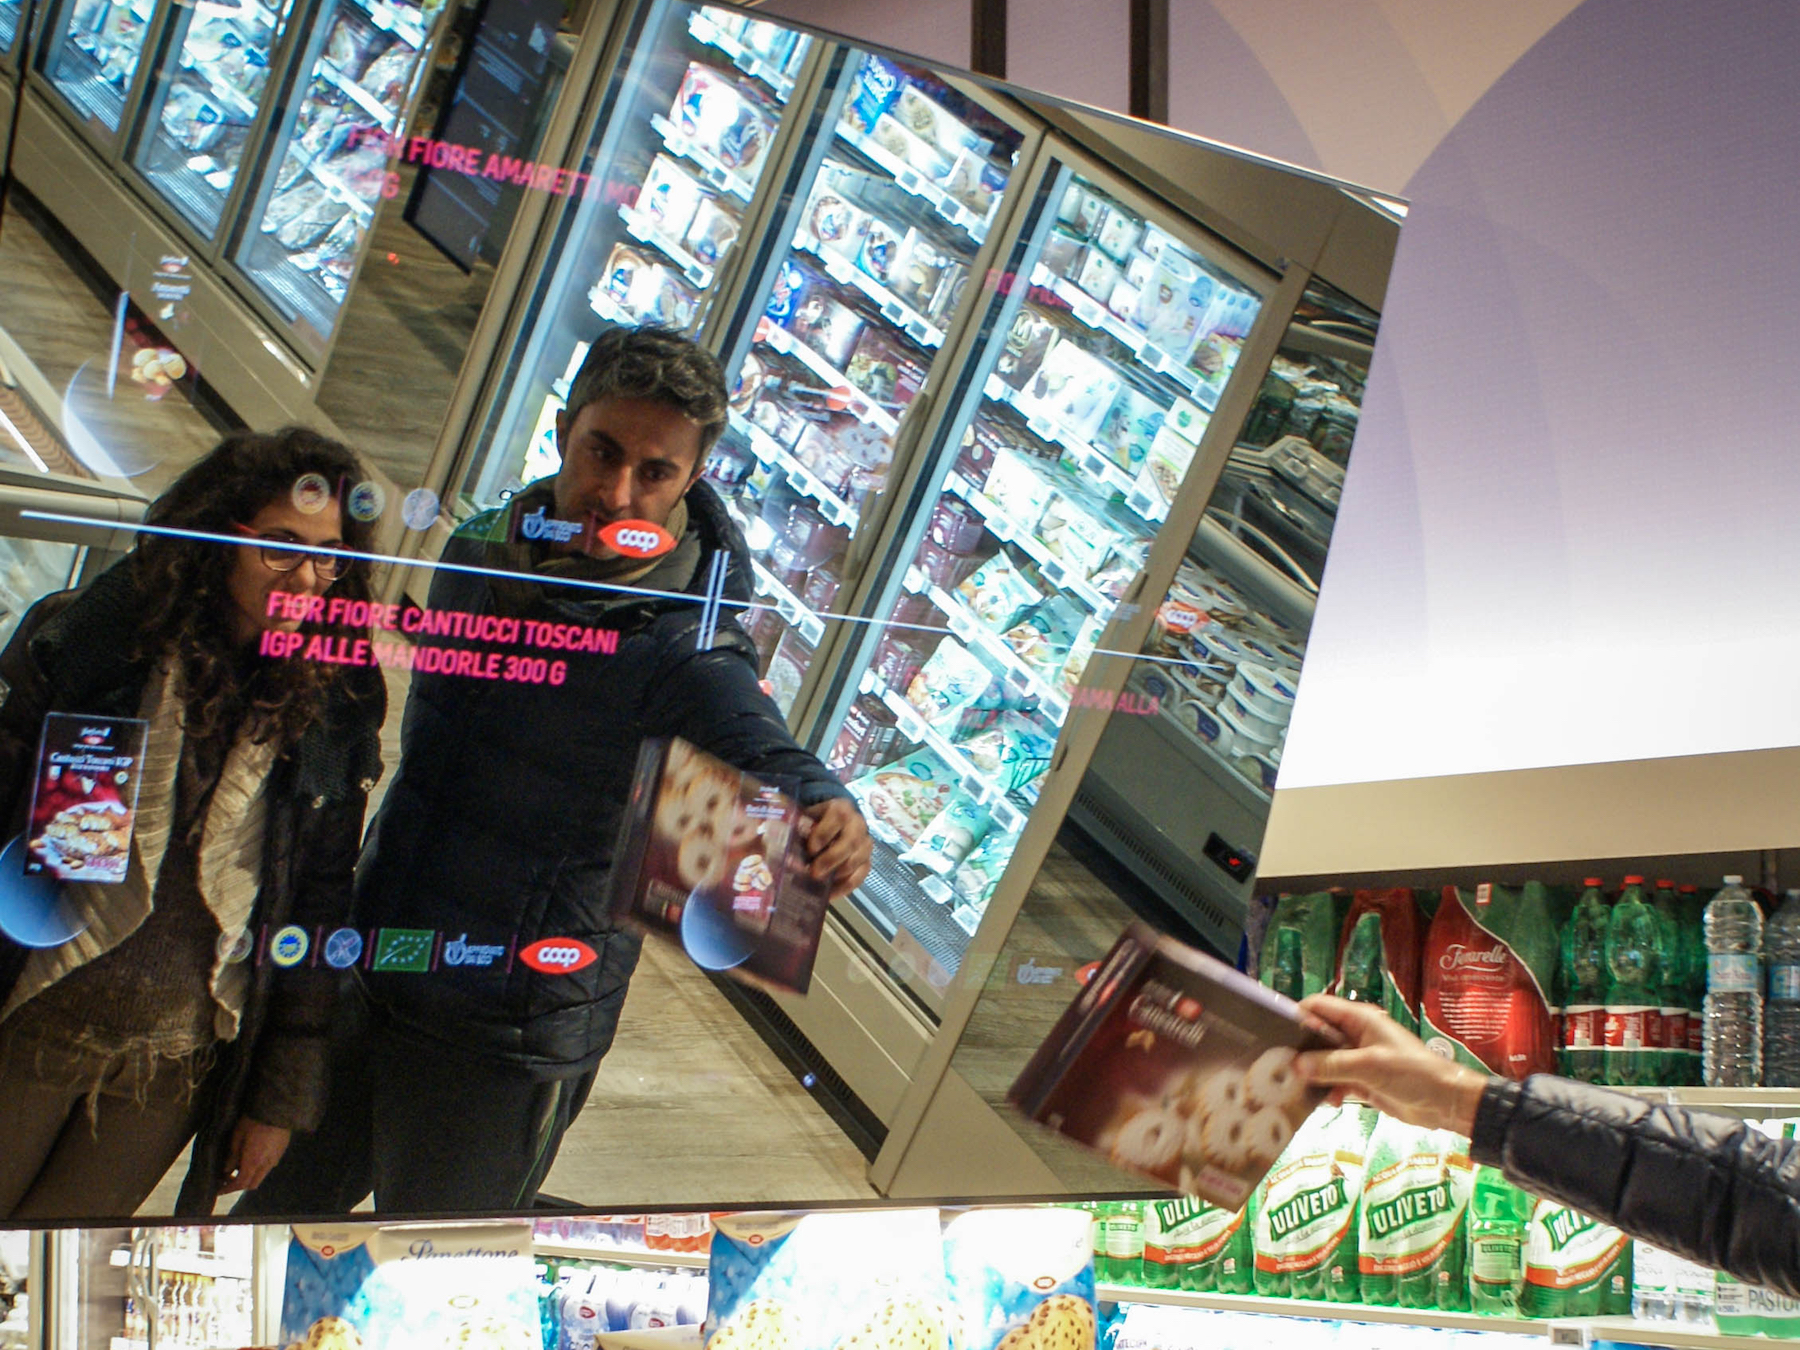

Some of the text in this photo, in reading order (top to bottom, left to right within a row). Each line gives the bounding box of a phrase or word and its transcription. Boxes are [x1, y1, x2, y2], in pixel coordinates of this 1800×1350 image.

[407, 135, 483, 176] FIORE
[616, 528, 660, 552] coop
[267, 591, 620, 655] FIOR FIORE CANTUCCI TOSCANI
[259, 630, 568, 686] IGP ALLE MANDORLE 300 G
[537, 946, 581, 969] coop
[1162, 1192, 1213, 1226] ULIV
[1271, 1184, 1339, 1235] ULIVETO
[1372, 1185, 1447, 1234] ULIVETO
